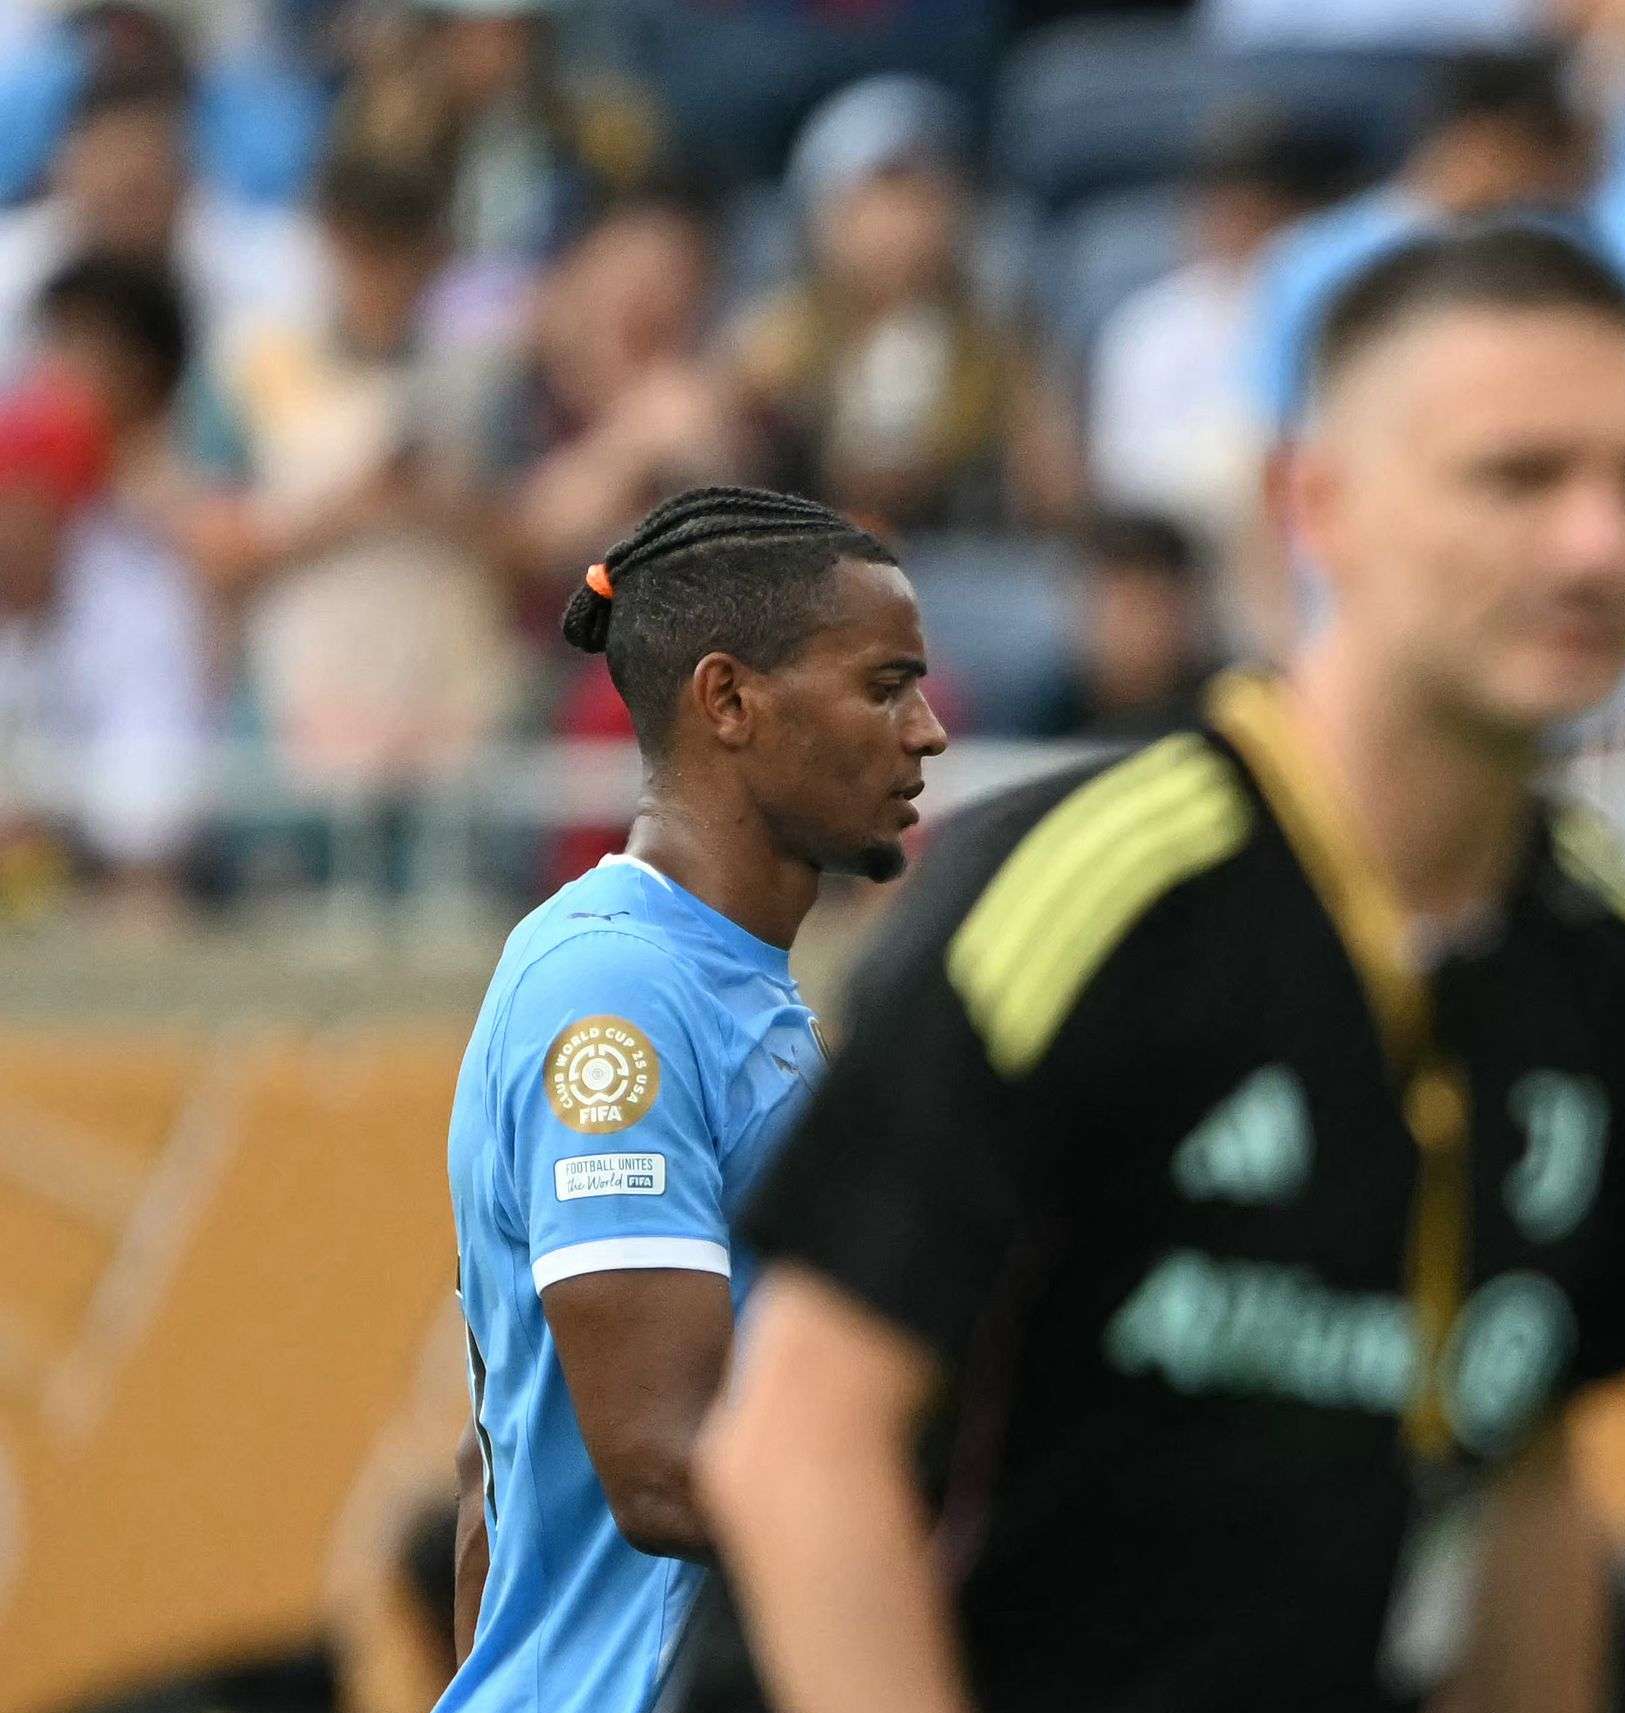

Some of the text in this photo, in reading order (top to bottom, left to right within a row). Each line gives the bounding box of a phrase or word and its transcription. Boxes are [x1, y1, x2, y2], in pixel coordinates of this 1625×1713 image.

[555, 1027, 600, 1067] WORLD
[605, 1027, 636, 1047] CUP
[554, 1072, 574, 1109] CLUB
[626, 1074, 648, 1103] USA
[579, 1105, 622, 1125] FIFA
[565, 1158, 653, 1175] FOOTBALL UNITES
[567, 1172, 653, 1193] the World FIFA
